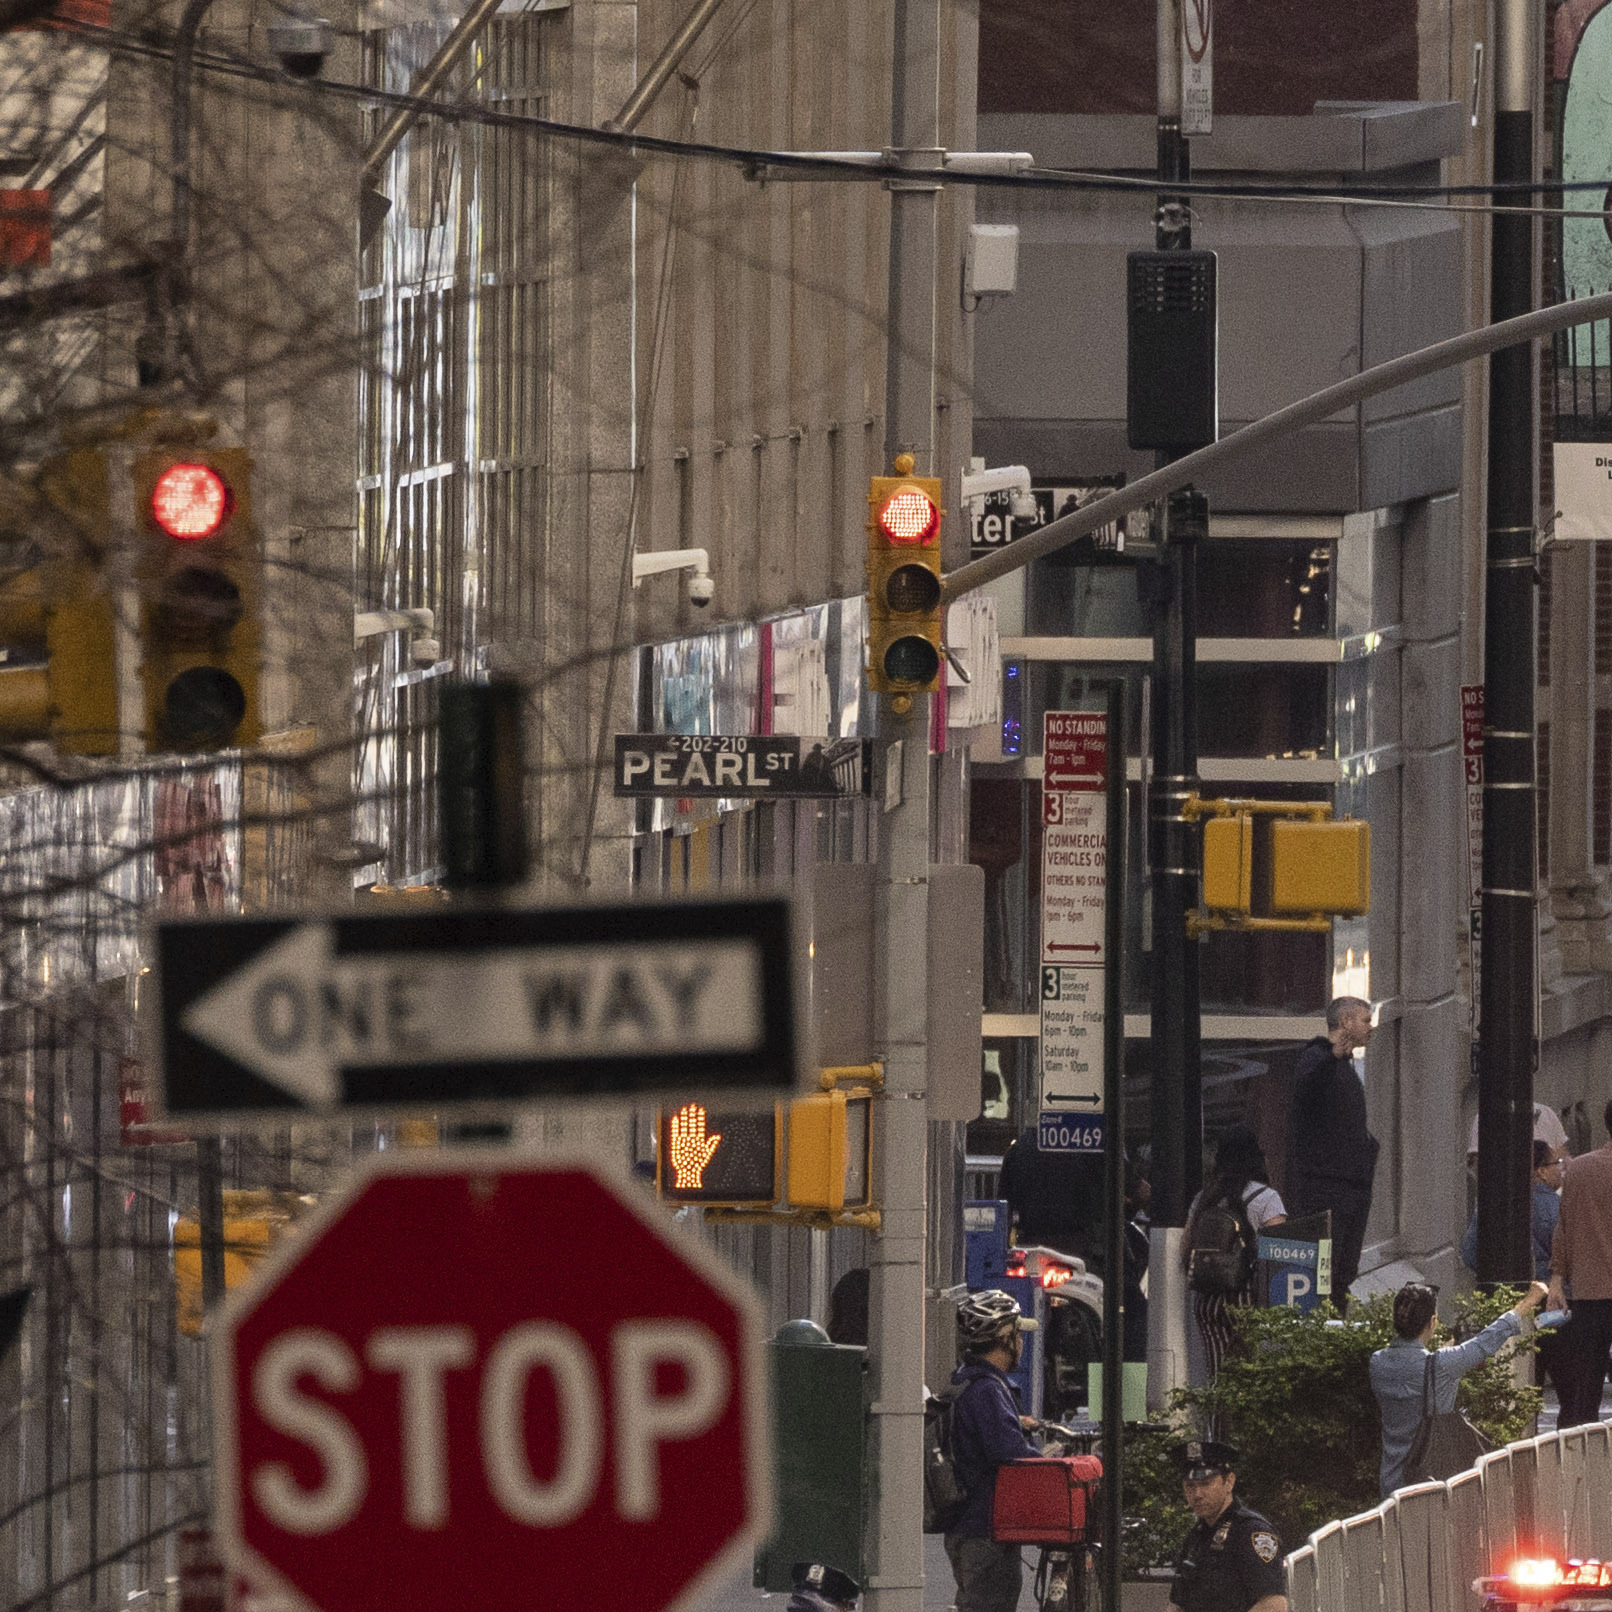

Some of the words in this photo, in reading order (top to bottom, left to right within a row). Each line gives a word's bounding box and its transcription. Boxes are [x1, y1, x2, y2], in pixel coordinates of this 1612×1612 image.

[1048, 719, 1064, 735] NO
[1065, 719, 1106, 736] STANDIN
[682, 736, 748, 753] 202-210
[1048, 738, 1077, 751] Monday
[1048, 753, 1065, 765] 7am
[623, 751, 771, 787] PEARL
[765, 752, 794, 771] ST
[1468, 759, 1480, 782] 3
[1047, 793, 1061, 823] 3
[1048, 833, 1106, 849] COMMERCIA
[1047, 851, 1092, 867] VEHICLES
[1046, 874, 1075, 887] OTHERS
[1075, 875, 1086, 887] NO
[1046, 895, 1075, 909] Monday
[1067, 911, 1084, 923] 6pm
[1044, 968, 1058, 999] 3
[250, 970, 434, 1056] ONE
[522, 961, 713, 1047] WAY
[1044, 1010, 1075, 1024] Monday
[1044, 1025, 1062, 1038] 6pm
[1068, 1025, 1088, 1038] 10pm
[1044, 1045, 1080, 1059] Saturday
[1069, 1060, 1090, 1073] 10pm
[1041, 1127, 1102, 1148] 100469
[1269, 1247, 1315, 1260] 100469
[1286, 1273, 1311, 1309] P
[250, 1318, 731, 1536] STOP
